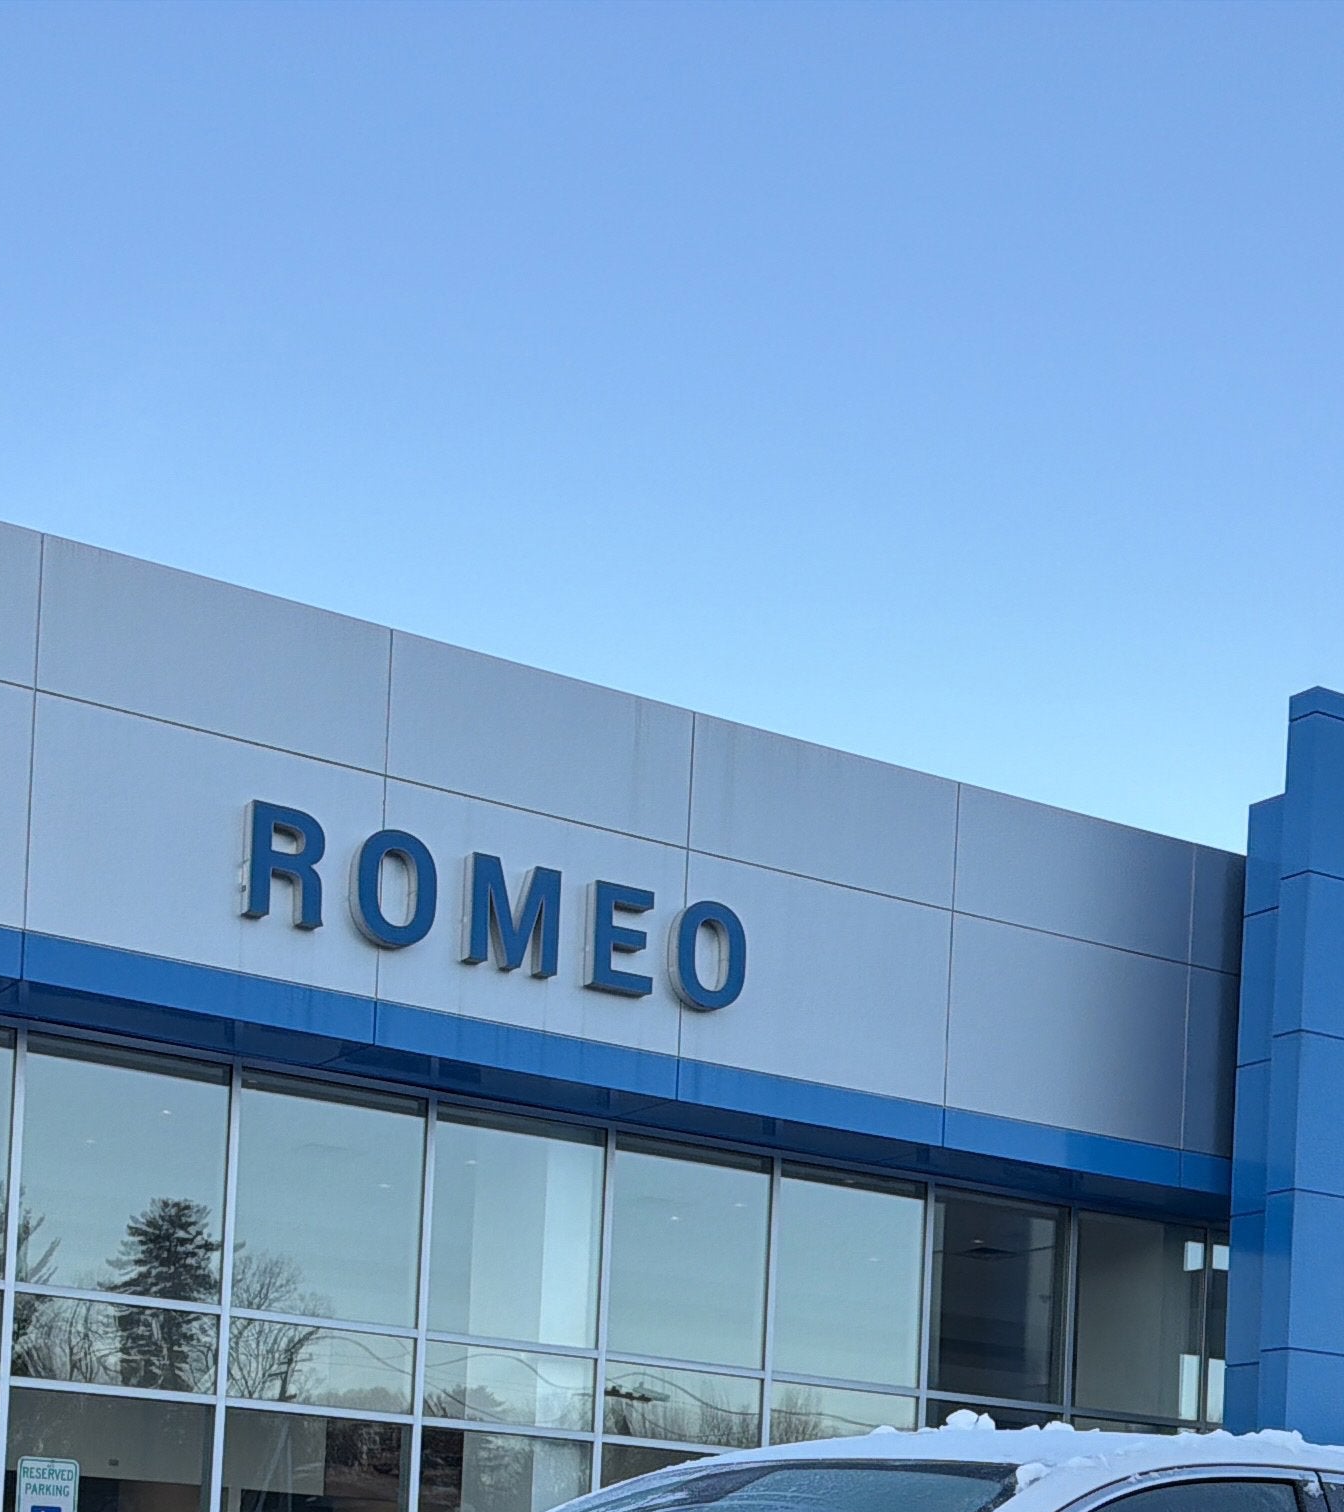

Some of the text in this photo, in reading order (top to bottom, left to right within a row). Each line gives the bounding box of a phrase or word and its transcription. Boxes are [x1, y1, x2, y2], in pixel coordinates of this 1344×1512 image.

[240, 799, 747, 1013] ROMEO
[22, 1466, 74, 1481] RESERVED
[24, 1482, 70, 1497] PARKING
